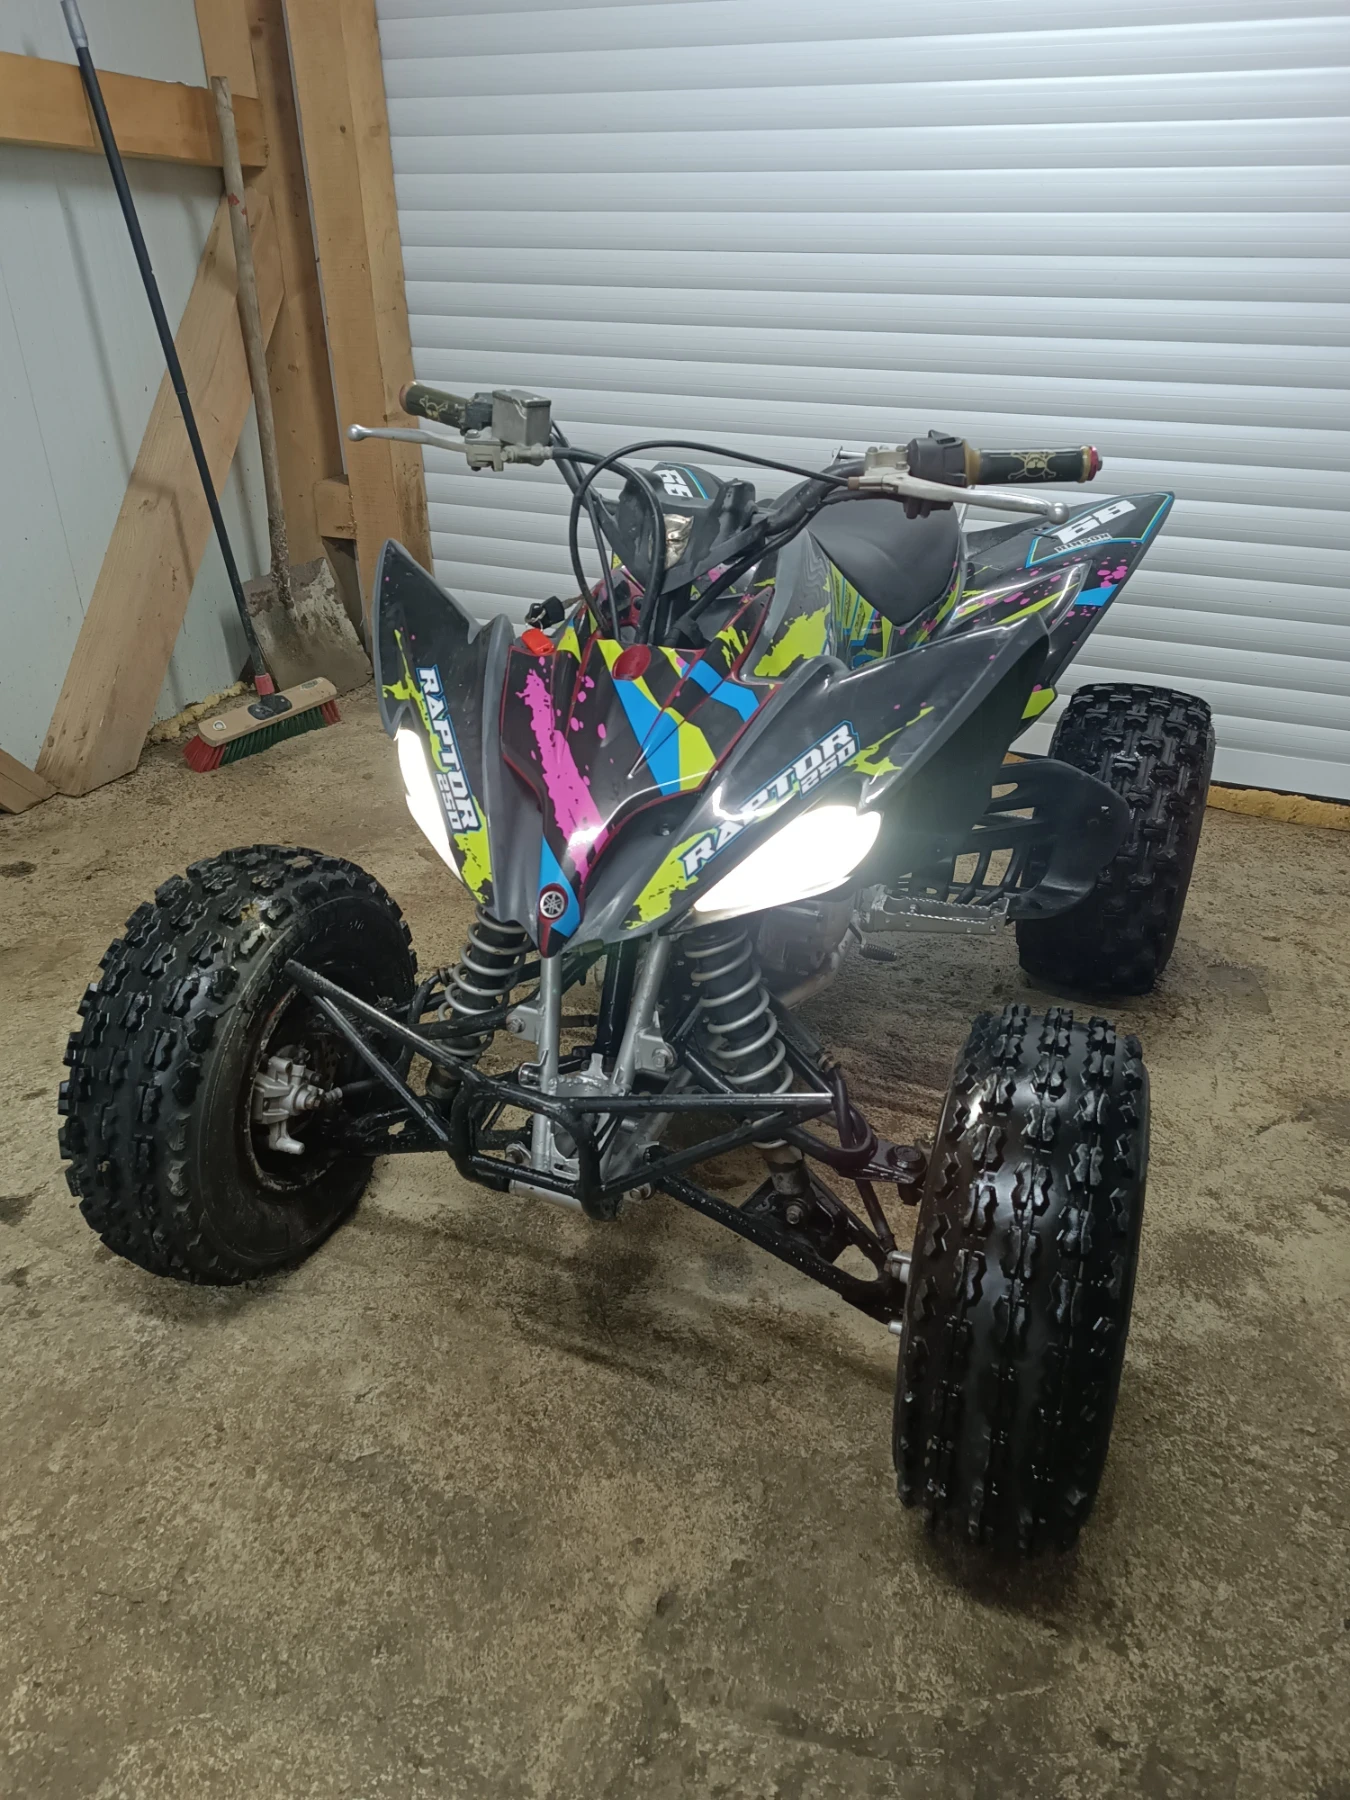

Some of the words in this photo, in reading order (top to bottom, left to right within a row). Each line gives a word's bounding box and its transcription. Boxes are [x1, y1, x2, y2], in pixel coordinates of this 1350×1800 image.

[419, 668, 480, 829] RAPTOR
[682, 724, 853, 876] RAPTOR
[801, 740, 856, 794] 250
[436, 773, 464, 831] 250
